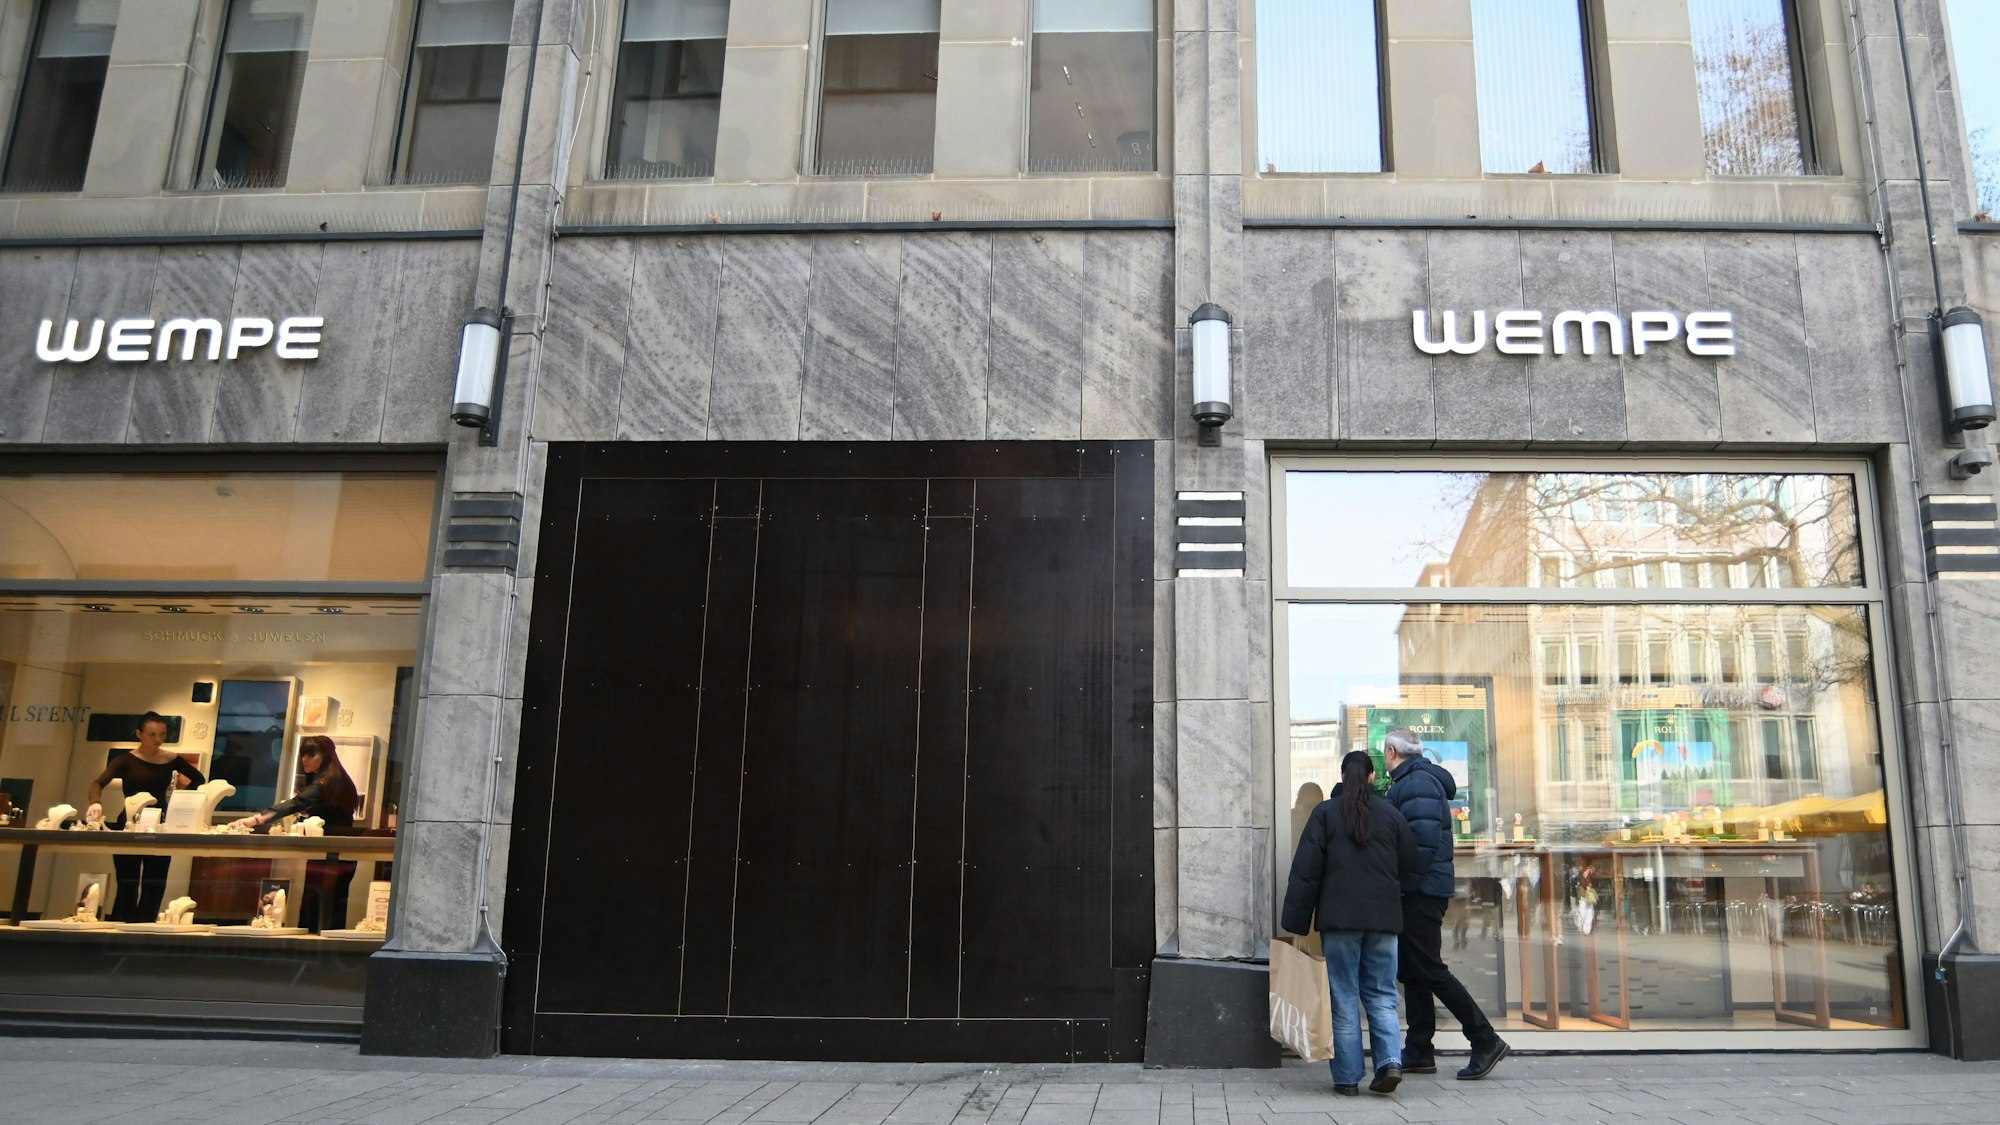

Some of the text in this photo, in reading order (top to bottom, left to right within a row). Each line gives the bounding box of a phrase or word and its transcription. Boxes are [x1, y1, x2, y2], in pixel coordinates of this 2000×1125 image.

[36, 317, 324, 362] WEMPE
[1412, 309, 1736, 356] WEMPE
[143, 630, 223, 642] SCHMUCK
[248, 631, 327, 643] JUWELEN
[25, 705, 90, 722] SPENT
[1409, 725, 1445, 734] ROLEX
[1653, 726, 1688, 734] ROLEX
